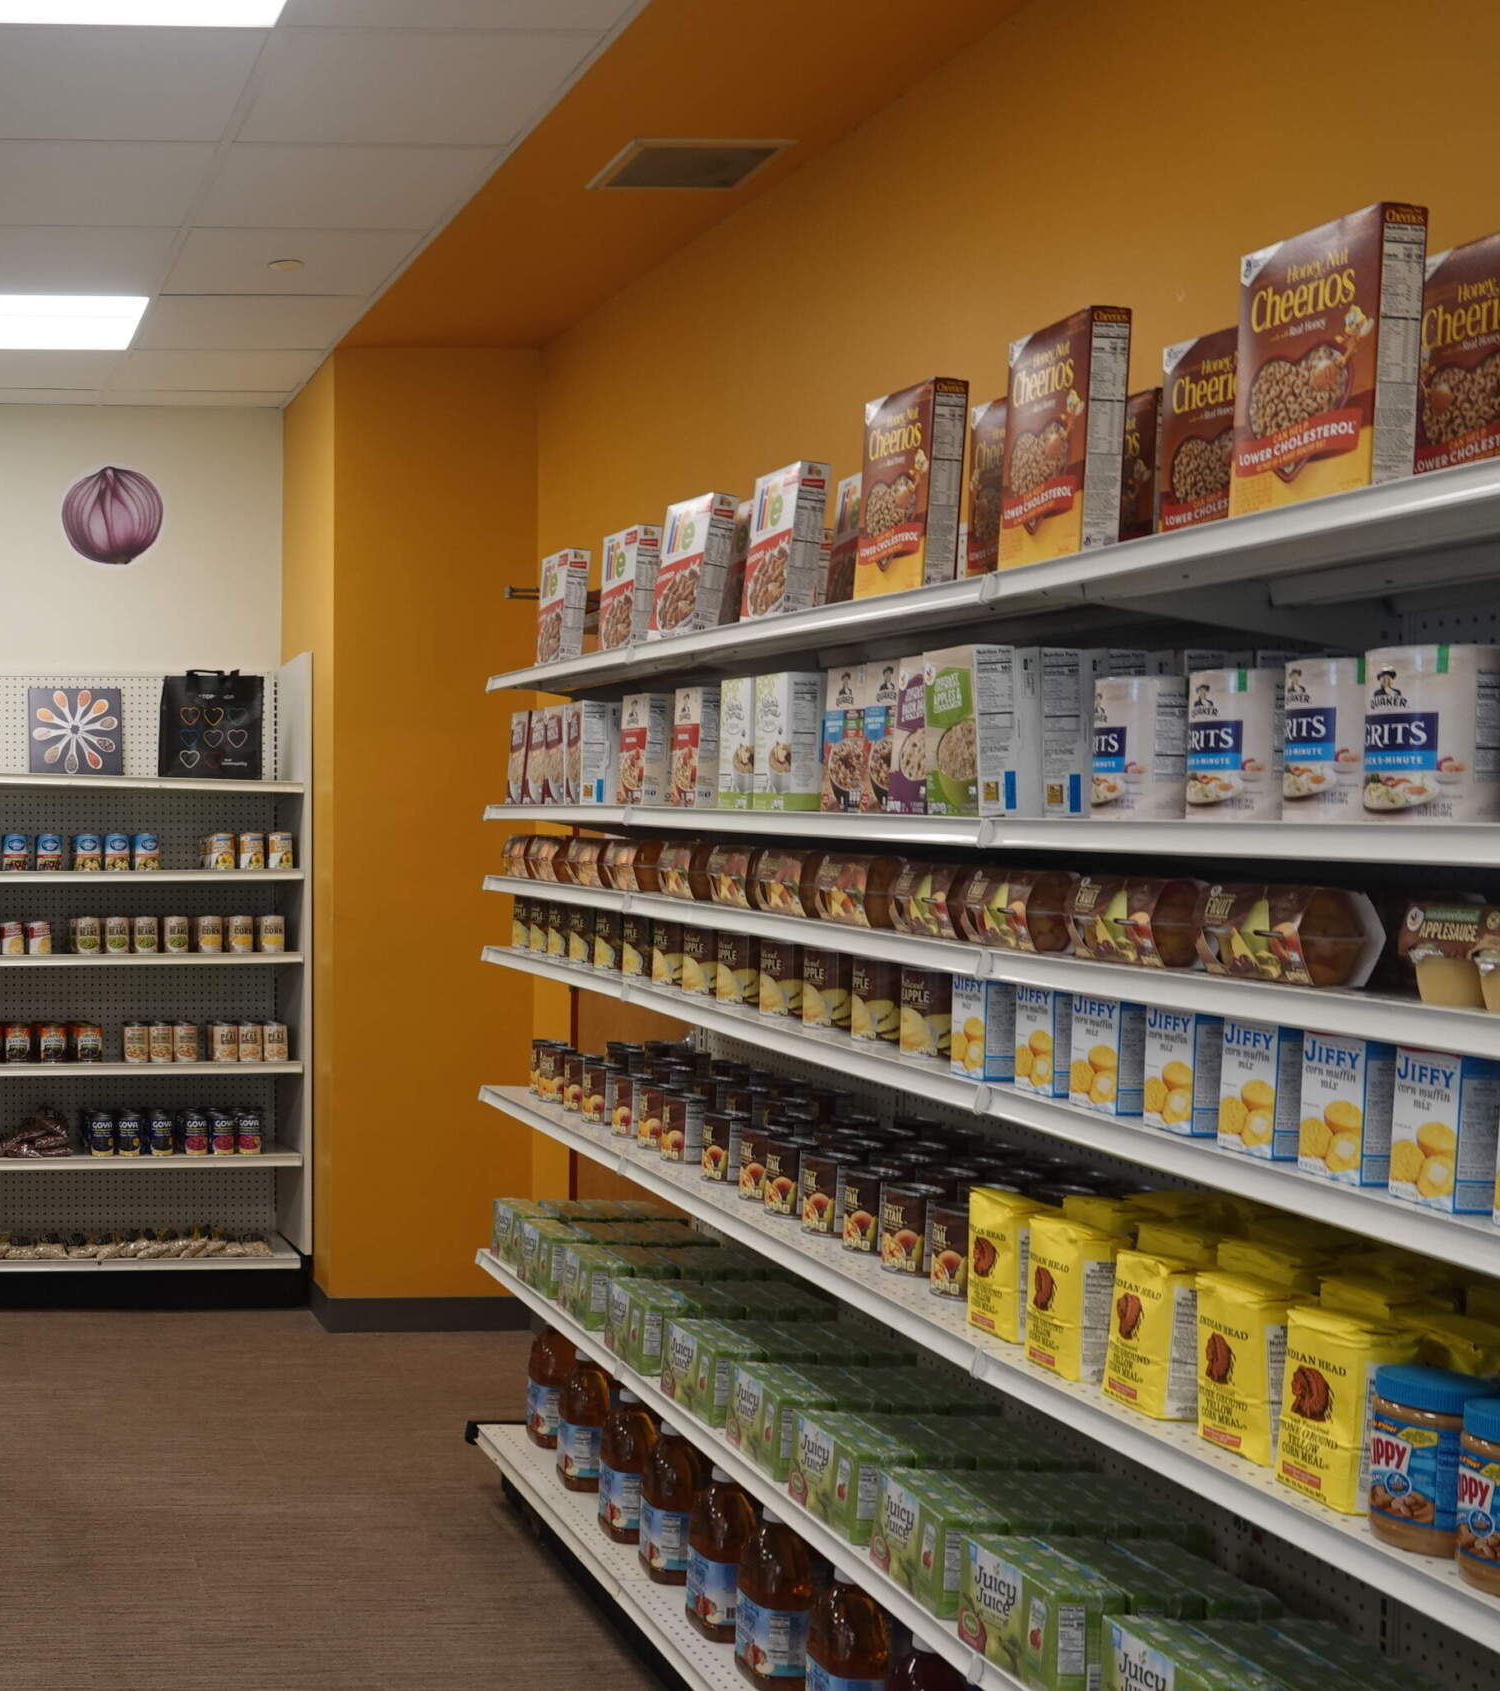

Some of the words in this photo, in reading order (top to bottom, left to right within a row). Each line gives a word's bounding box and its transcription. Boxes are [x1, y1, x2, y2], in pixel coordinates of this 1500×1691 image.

[1287, 260, 1322, 284] Honey
[1328, 248, 1349, 270] Nut
[1251, 269, 1355, 334] Cheerios
[1202, 357, 1231, 376] Honey
[1013, 358, 1074, 408] Cheerios
[869, 422, 922, 461] Cheerios
[1238, 448, 1273, 467] LOWER
[1273, 420, 1357, 456] CHOLESTEROL
[1003, 502, 1025, 521] LOWER
[1024, 485, 1073, 515] CHOLESTEROL
[877, 532, 919, 554] CHOLESTEROL
[1370, 695, 1408, 710] QUAKER
[1419, 920, 1479, 943] APPLESAUCE
[953, 976, 984, 993] JIFFY
[1017, 988, 1050, 1004] JIFFY
[1074, 996, 1116, 1019] JIFFY
[1147, 1009, 1190, 1033] JIFFY
[1224, 1022, 1274, 1050] JIFFY
[1224, 1047, 1242, 1058] corn
[1243, 1049, 1271, 1063] muffin
[1237, 1059, 1254, 1071] mix
[1304, 1039, 1360, 1070] JIFFY
[1304, 1064, 1324, 1076] corn
[1326, 1068, 1357, 1083] muffin
[1320, 1078, 1338, 1091] mix
[1397, 1055, 1455, 1090] JIFFY
[1397, 1083, 1417, 1096] corn
[1418, 1086, 1451, 1104] muffin
[1412, 1099, 1433, 1112] mix
[91, 1121, 113, 1129] GOYA
[118, 1121, 139, 1129] GOYA
[1223, 1325, 1249, 1342] HEAD
[735, 1382, 760, 1411] Juicy
[737, 1399, 758, 1423] Juice
[799, 1434, 830, 1467] Juicy
[1287, 1432, 1321, 1456] YELLOW
[1372, 1437, 1408, 1470] IPPY
[801, 1453, 827, 1476] Juice
[1300, 1450, 1326, 1471] MEAL
[884, 1496, 916, 1531] Juicy
[884, 1516, 912, 1540] Juice
[974, 1564, 1018, 1606] Juicy
[975, 1590, 1012, 1619] Juice
